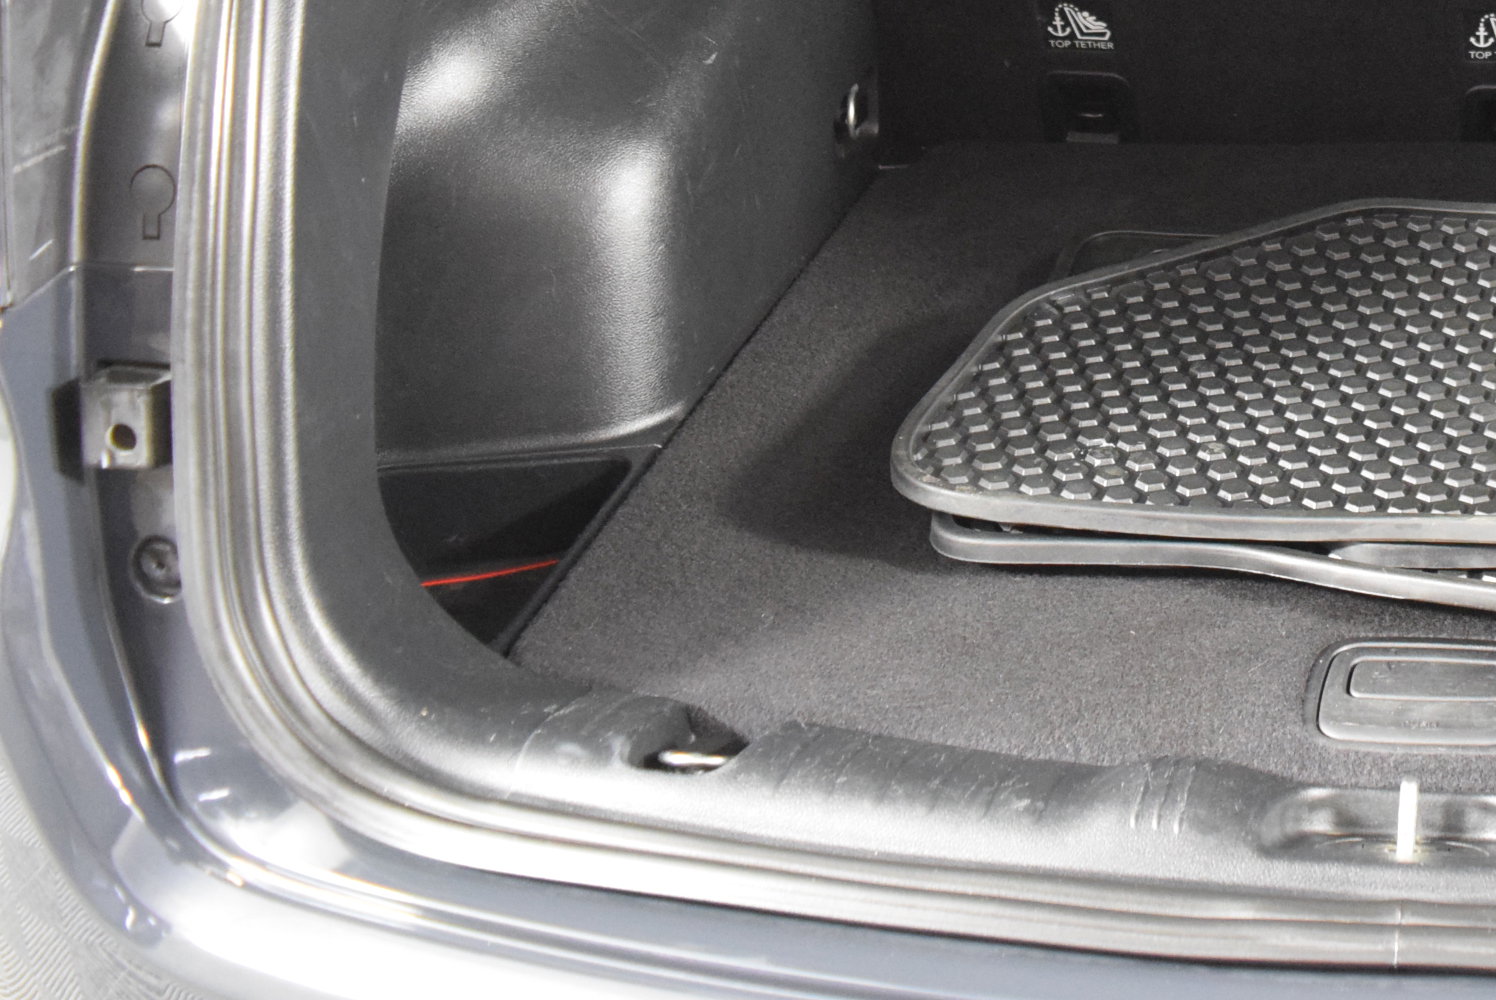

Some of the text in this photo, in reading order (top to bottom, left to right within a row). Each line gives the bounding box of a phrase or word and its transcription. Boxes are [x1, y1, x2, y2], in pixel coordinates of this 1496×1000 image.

[1048, 40, 1115, 50] TOP TETHER
[1468, 51, 1492, 60] TOP
